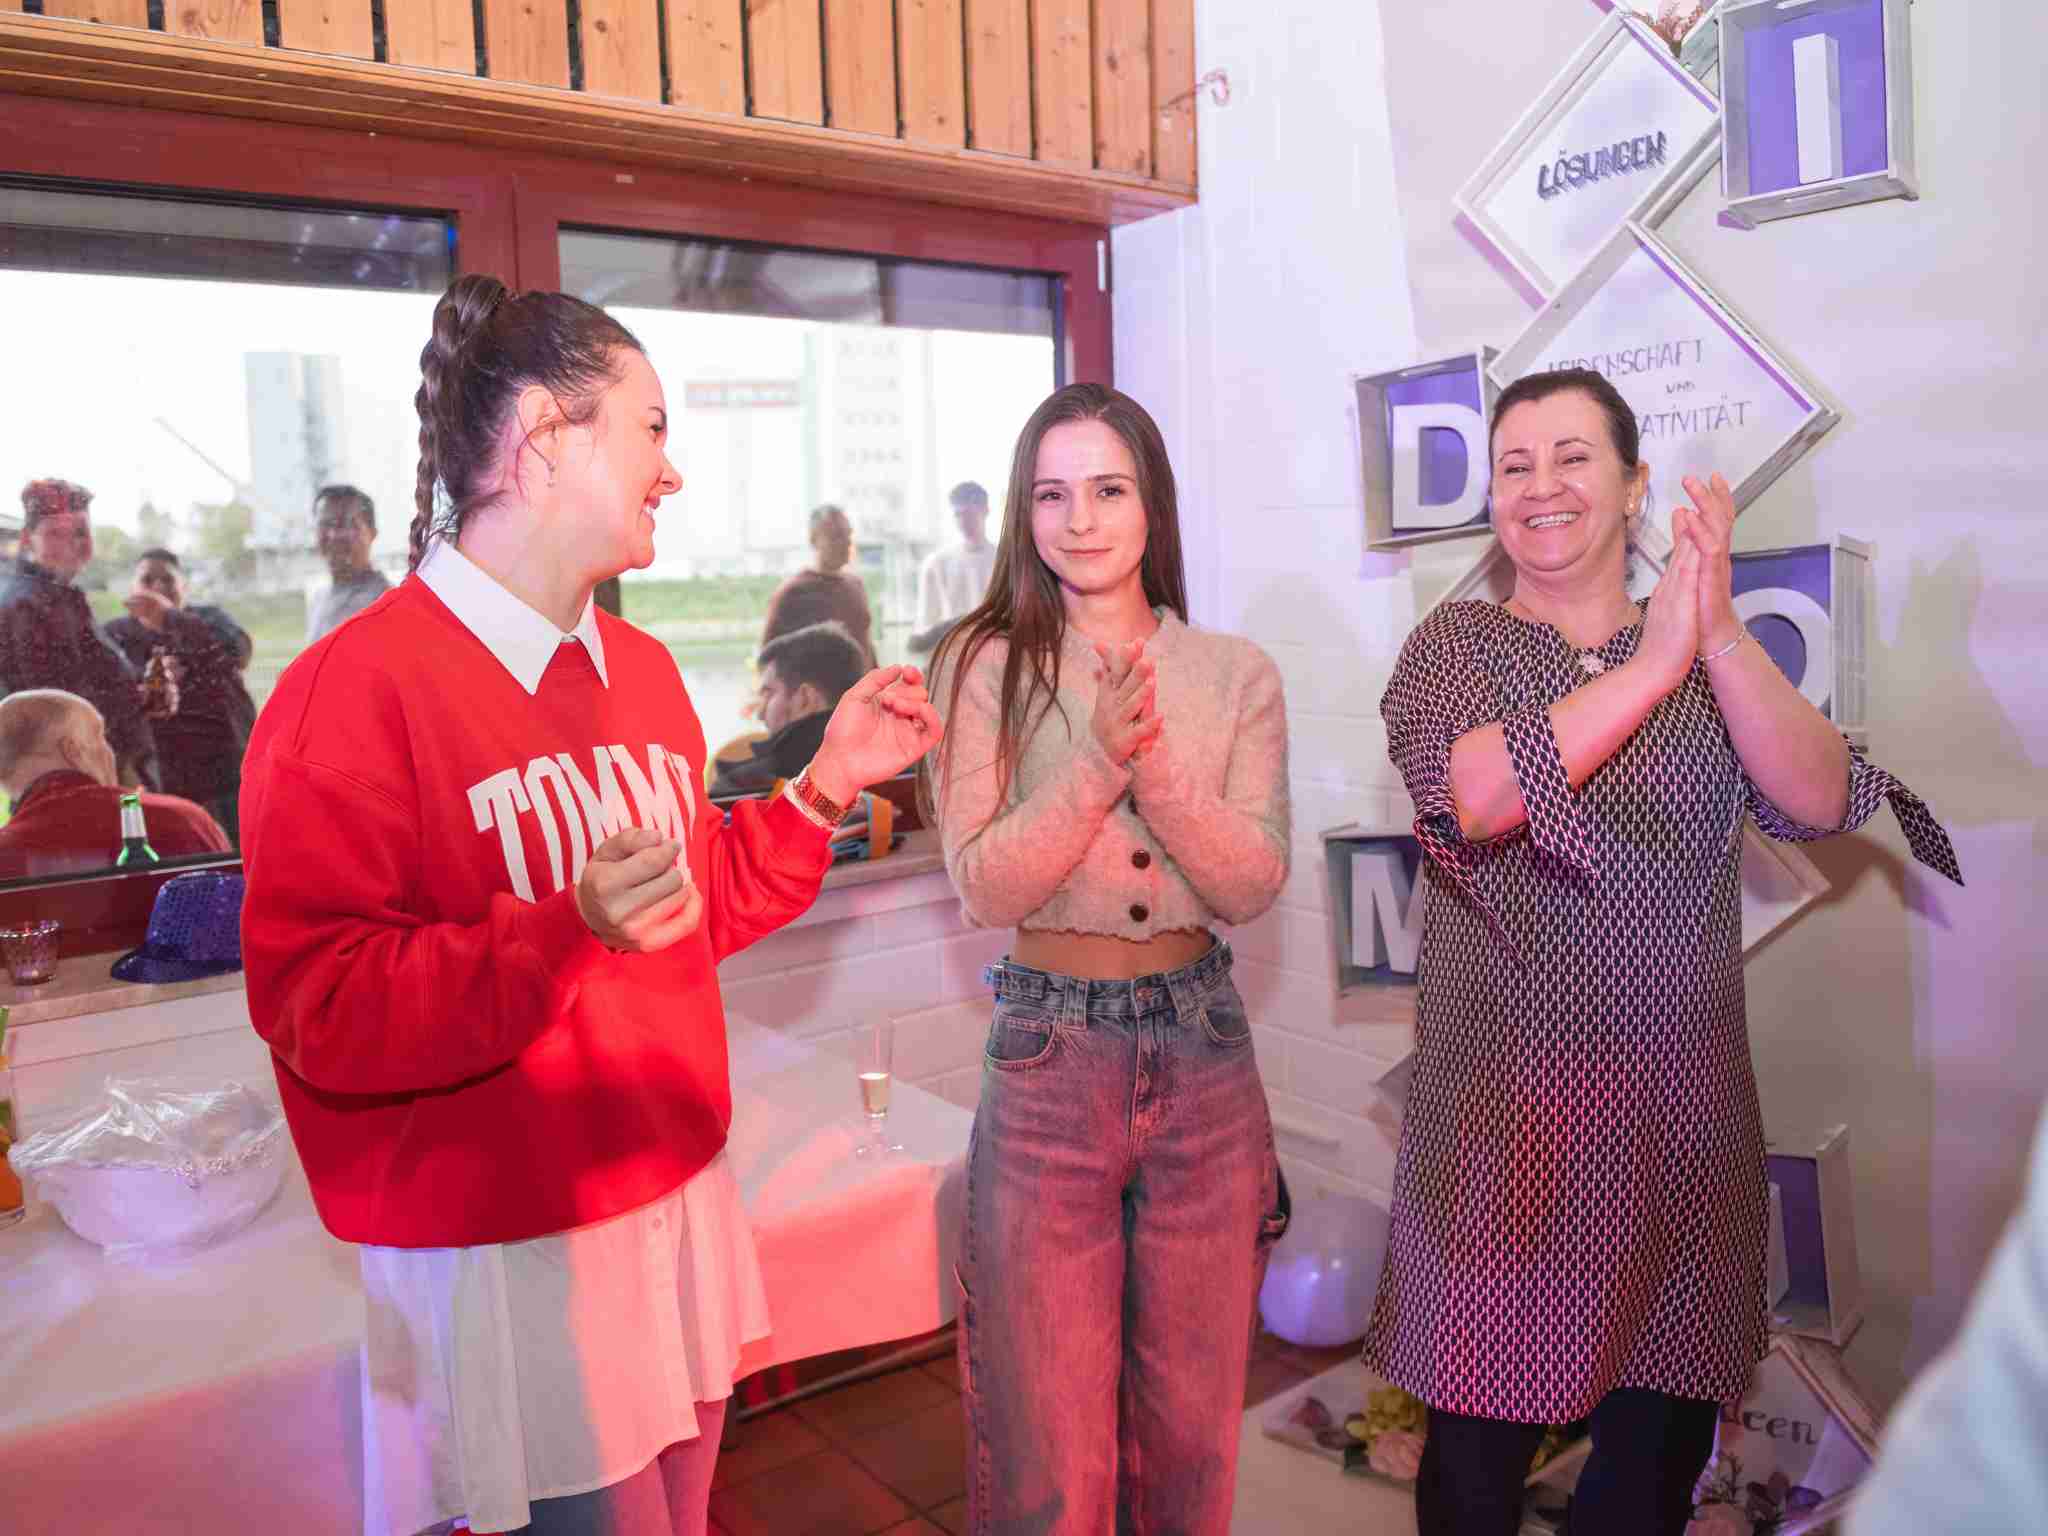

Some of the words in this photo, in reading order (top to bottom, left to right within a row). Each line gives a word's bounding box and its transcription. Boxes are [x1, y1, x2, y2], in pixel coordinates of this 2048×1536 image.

[1537, 131, 1667, 200] LÖSUNGEN
[1392, 403, 1490, 528] D
[1635, 394, 1752, 440] ATIVITÄT
[466, 743, 696, 904] TOMMY
